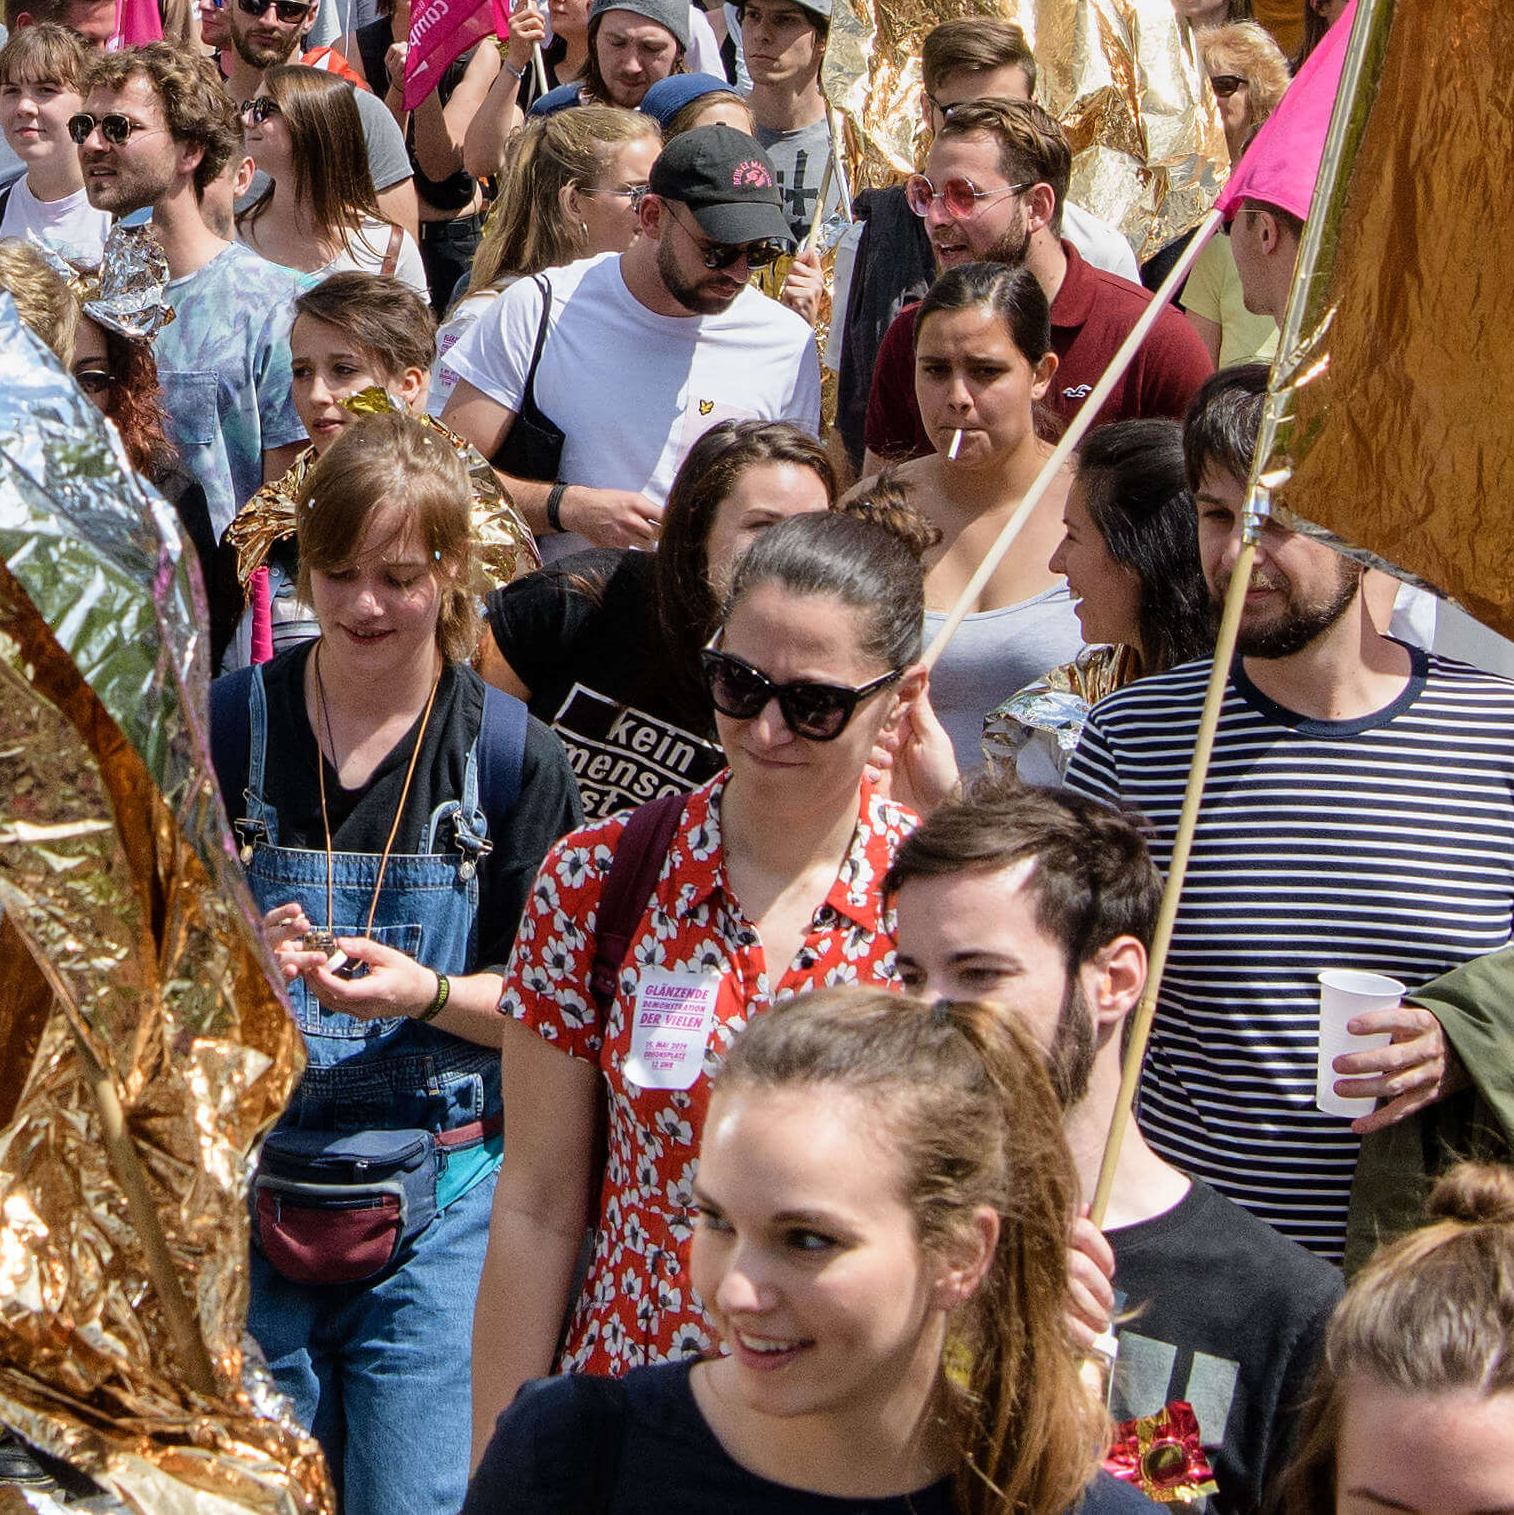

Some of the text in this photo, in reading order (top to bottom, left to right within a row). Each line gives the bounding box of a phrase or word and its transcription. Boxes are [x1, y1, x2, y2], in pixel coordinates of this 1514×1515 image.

[606, 719, 696, 774] kein
[645, 983, 709, 1000] GLÄNZENDE
[640, 1013, 703, 1028] DER VIELEN
